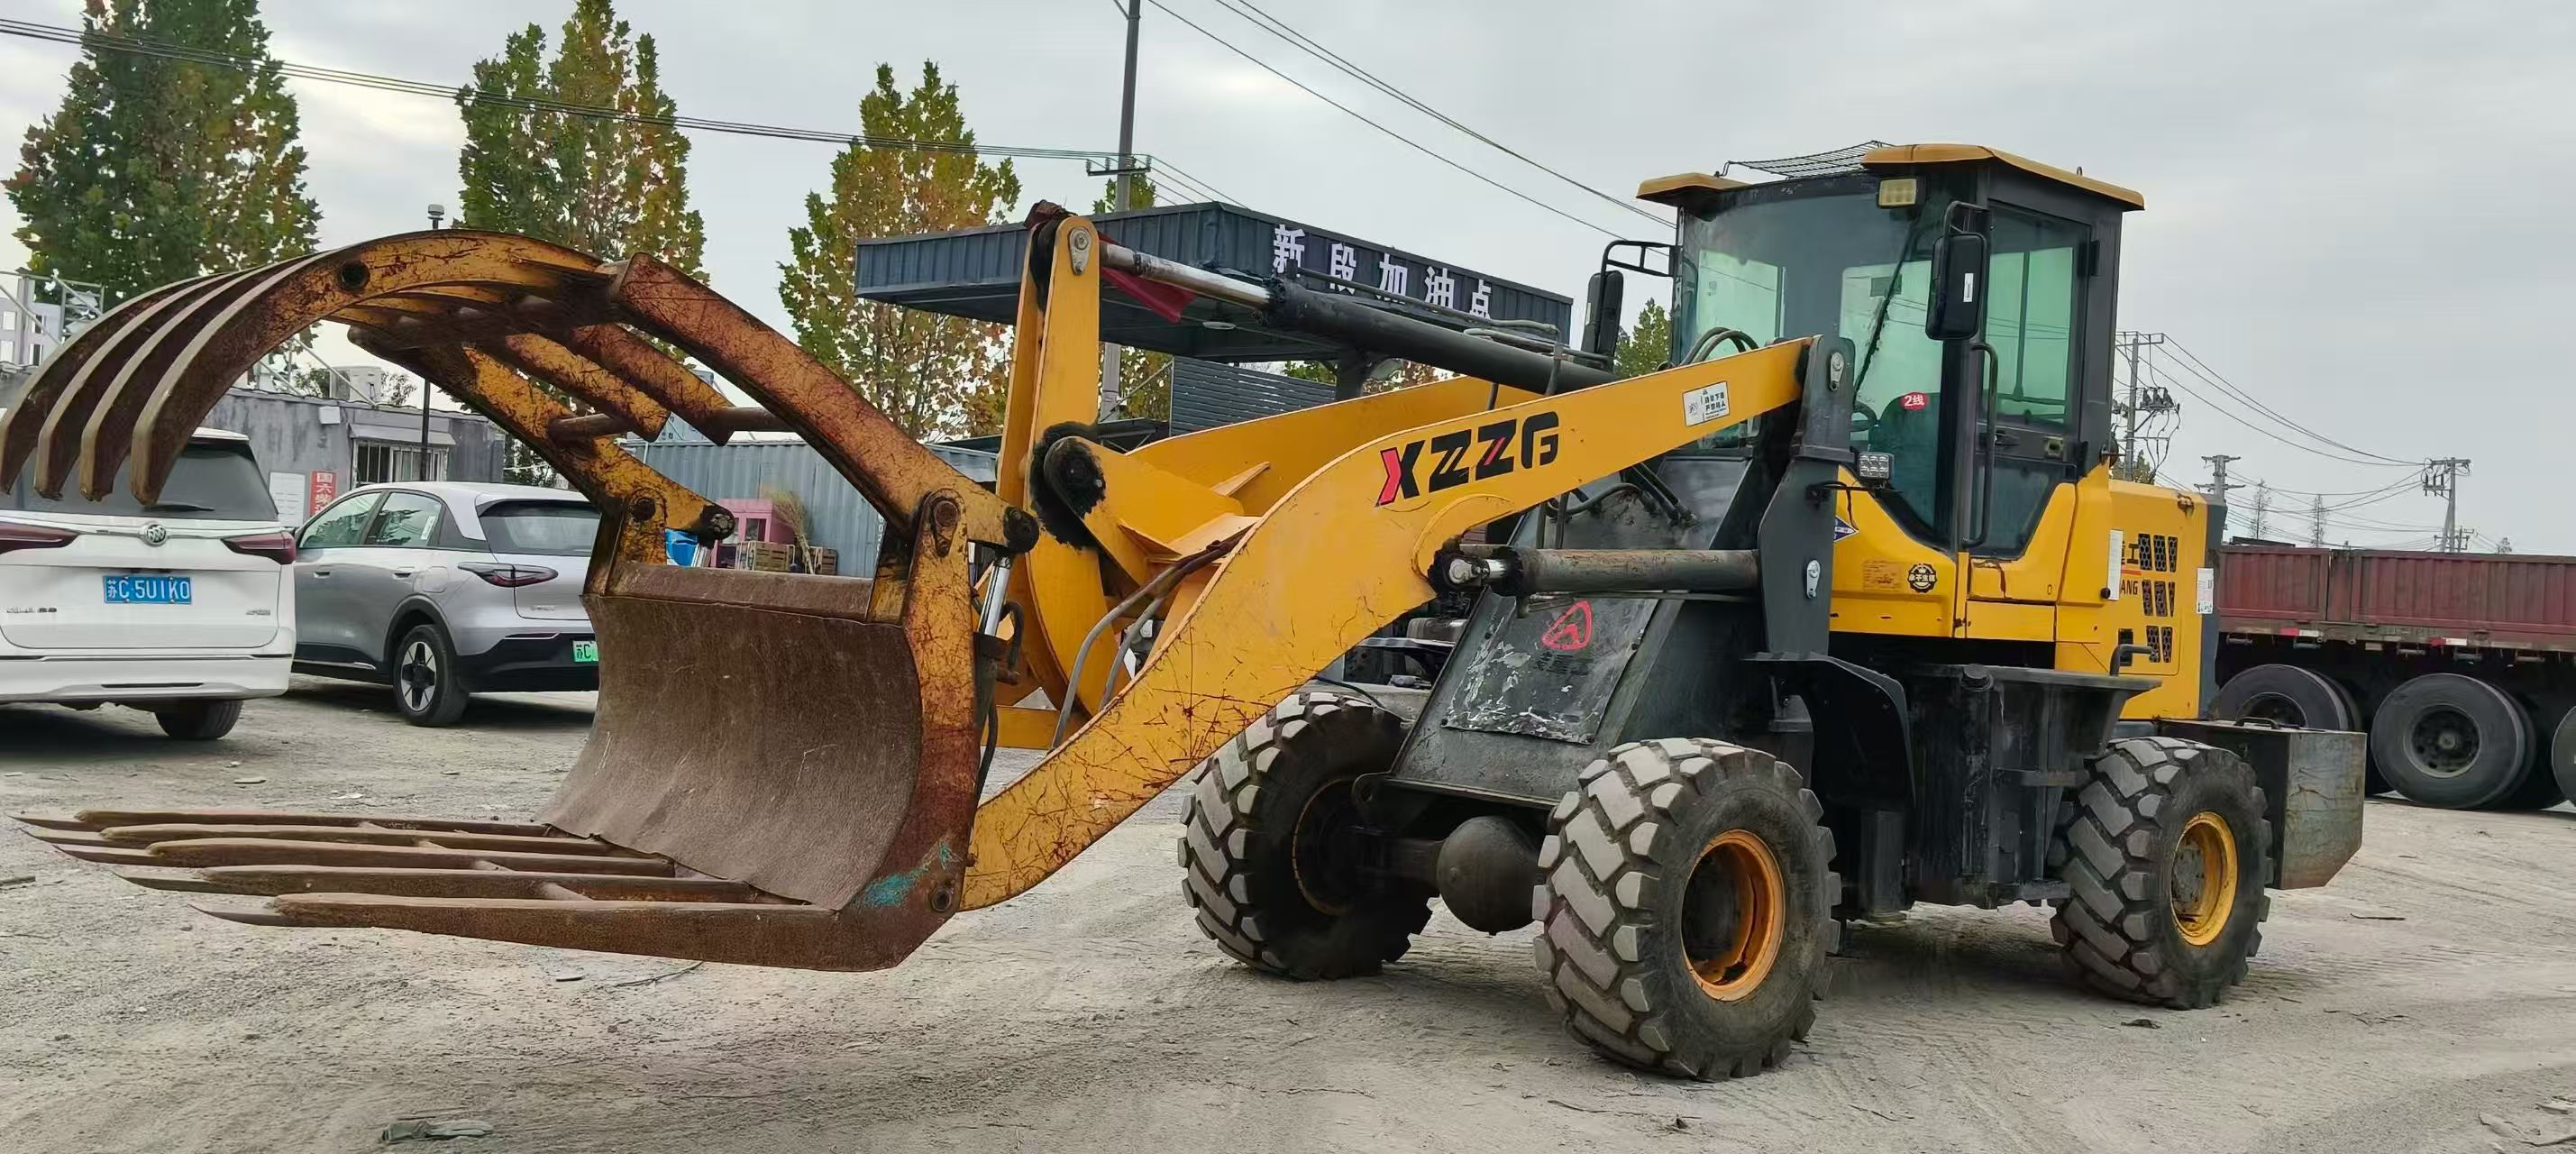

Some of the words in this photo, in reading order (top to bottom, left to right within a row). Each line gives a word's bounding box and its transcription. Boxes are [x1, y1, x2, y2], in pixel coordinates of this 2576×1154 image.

[1272, 224, 1493, 320] 新段加油点
[1904, 395, 1925, 407] 2线
[1375, 411, 1559, 507] XZZG
